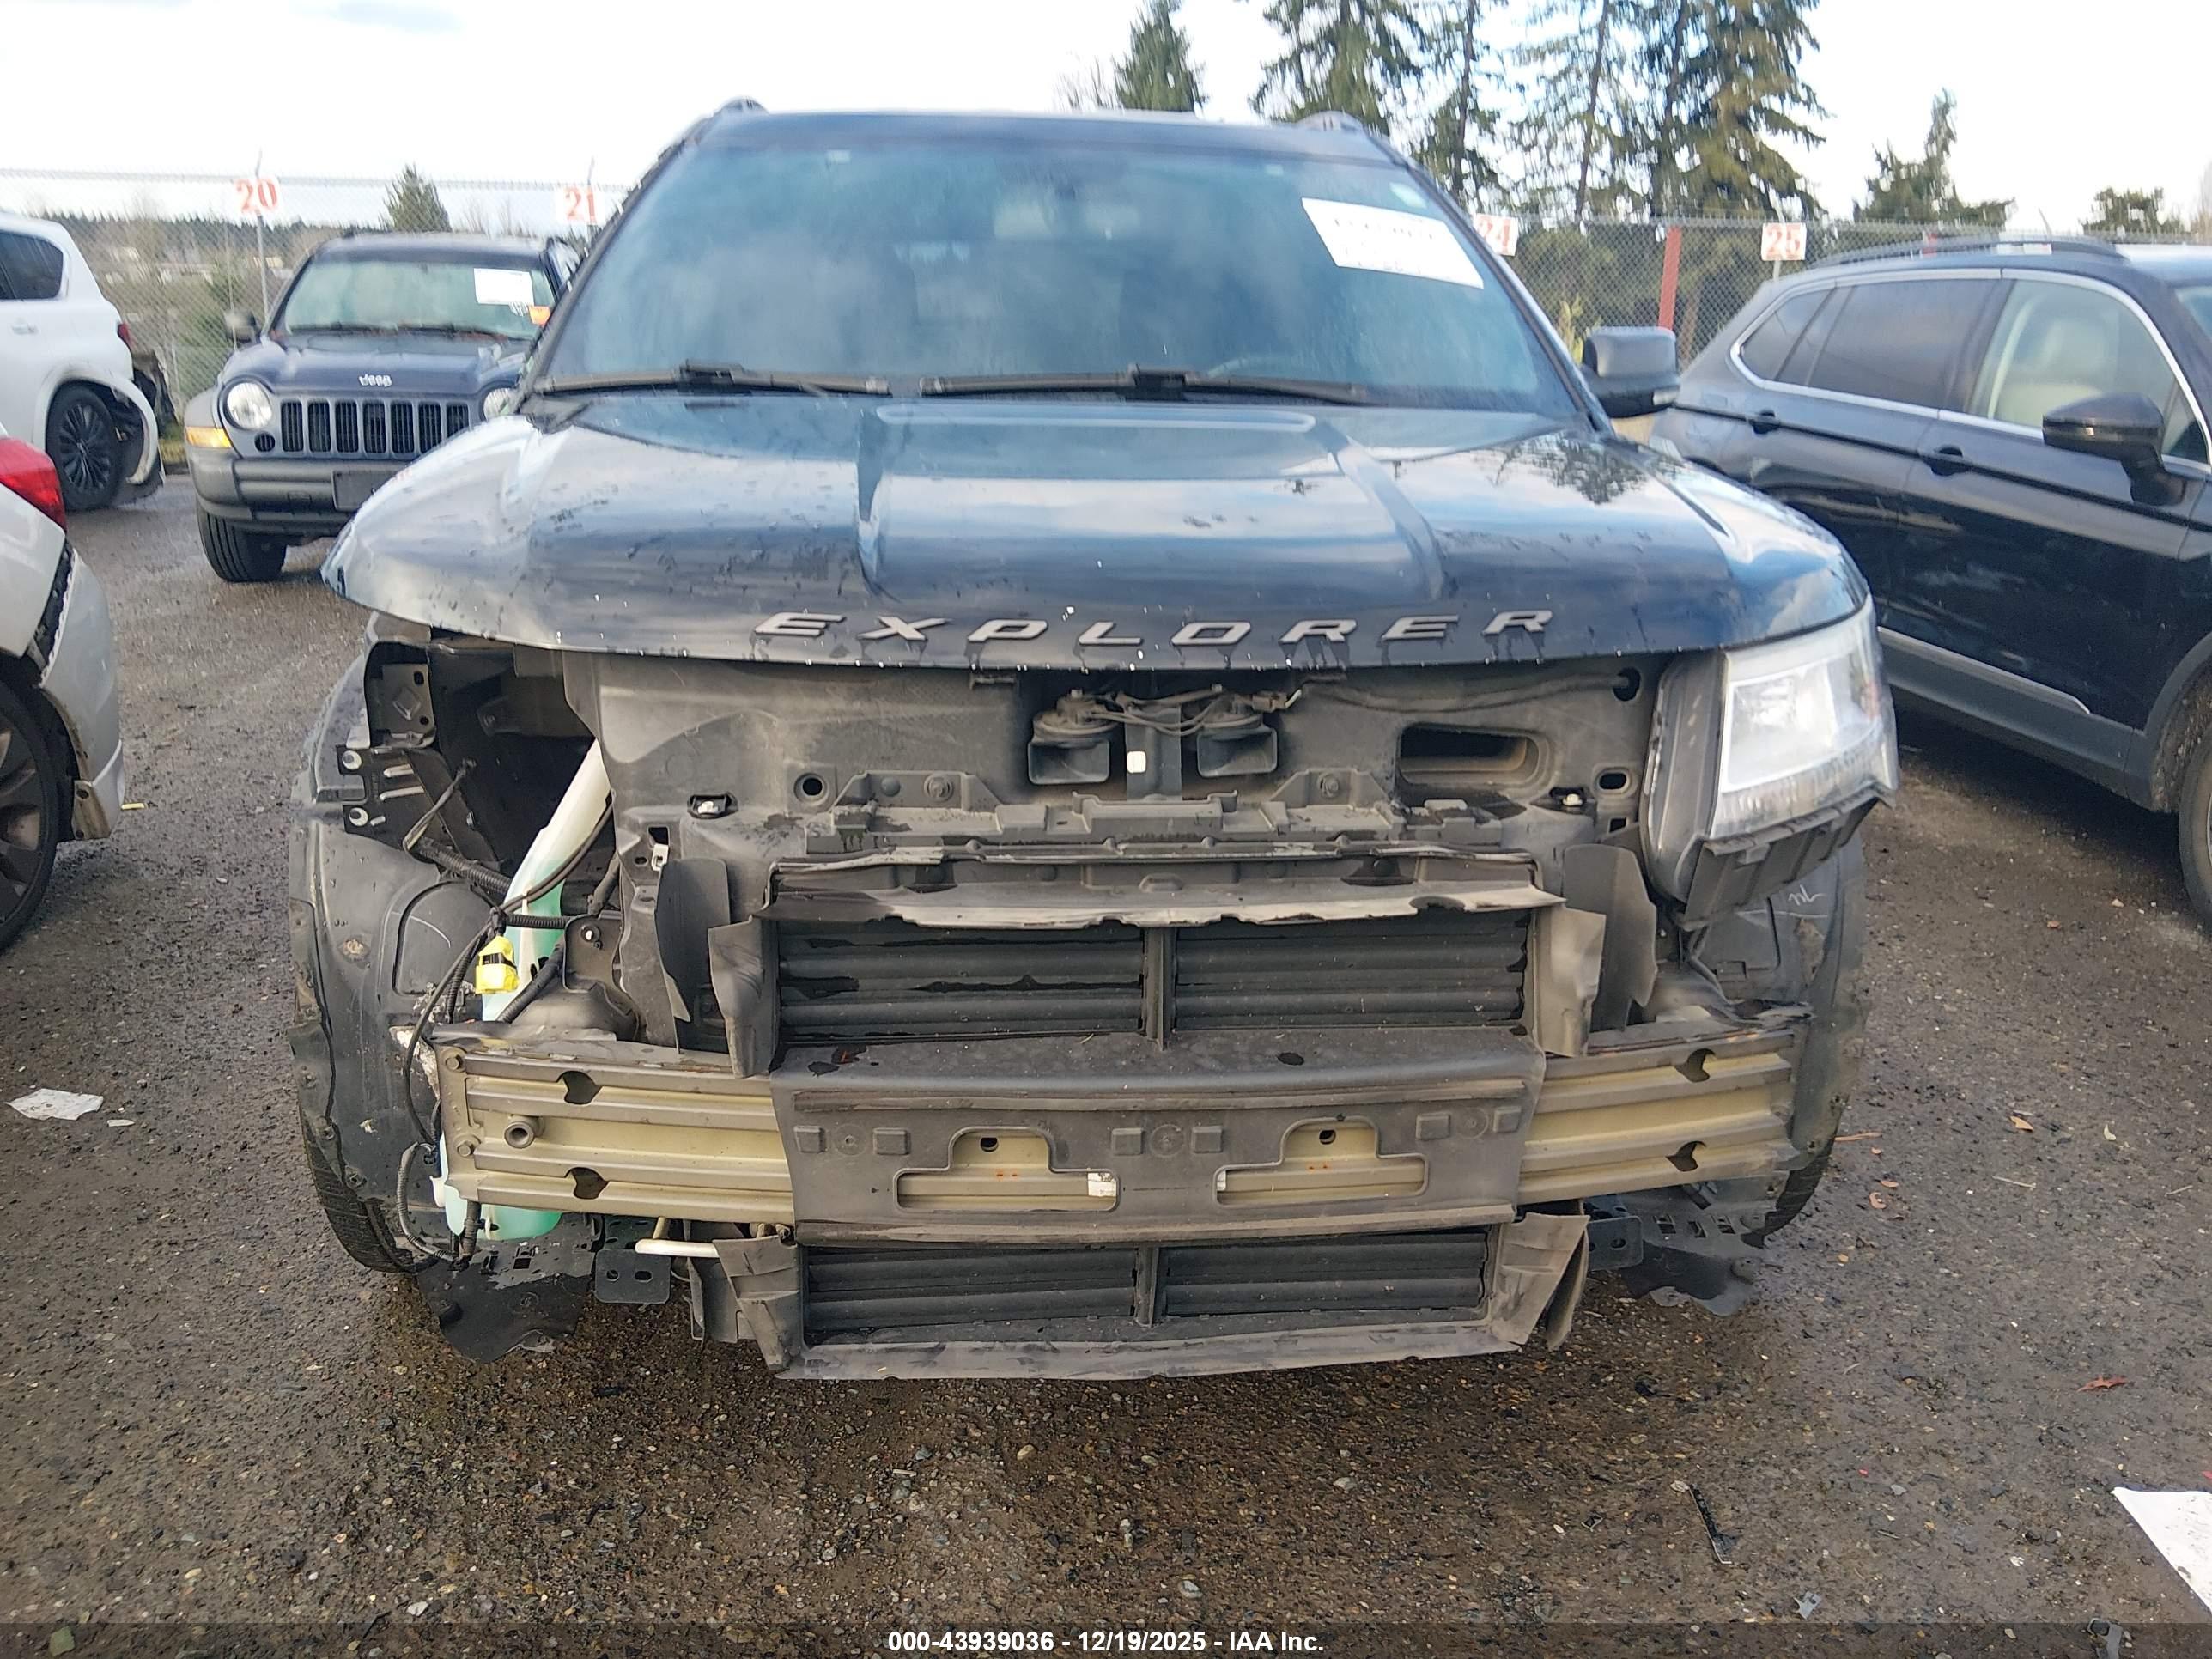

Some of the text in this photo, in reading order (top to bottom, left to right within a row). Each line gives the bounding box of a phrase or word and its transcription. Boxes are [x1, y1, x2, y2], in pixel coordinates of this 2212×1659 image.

[236, 179, 277, 212] 20
[564, 185, 596, 222] 21
[1766, 223, 1801, 260] 25
[754, 609, 1553, 647] EXPLORER
